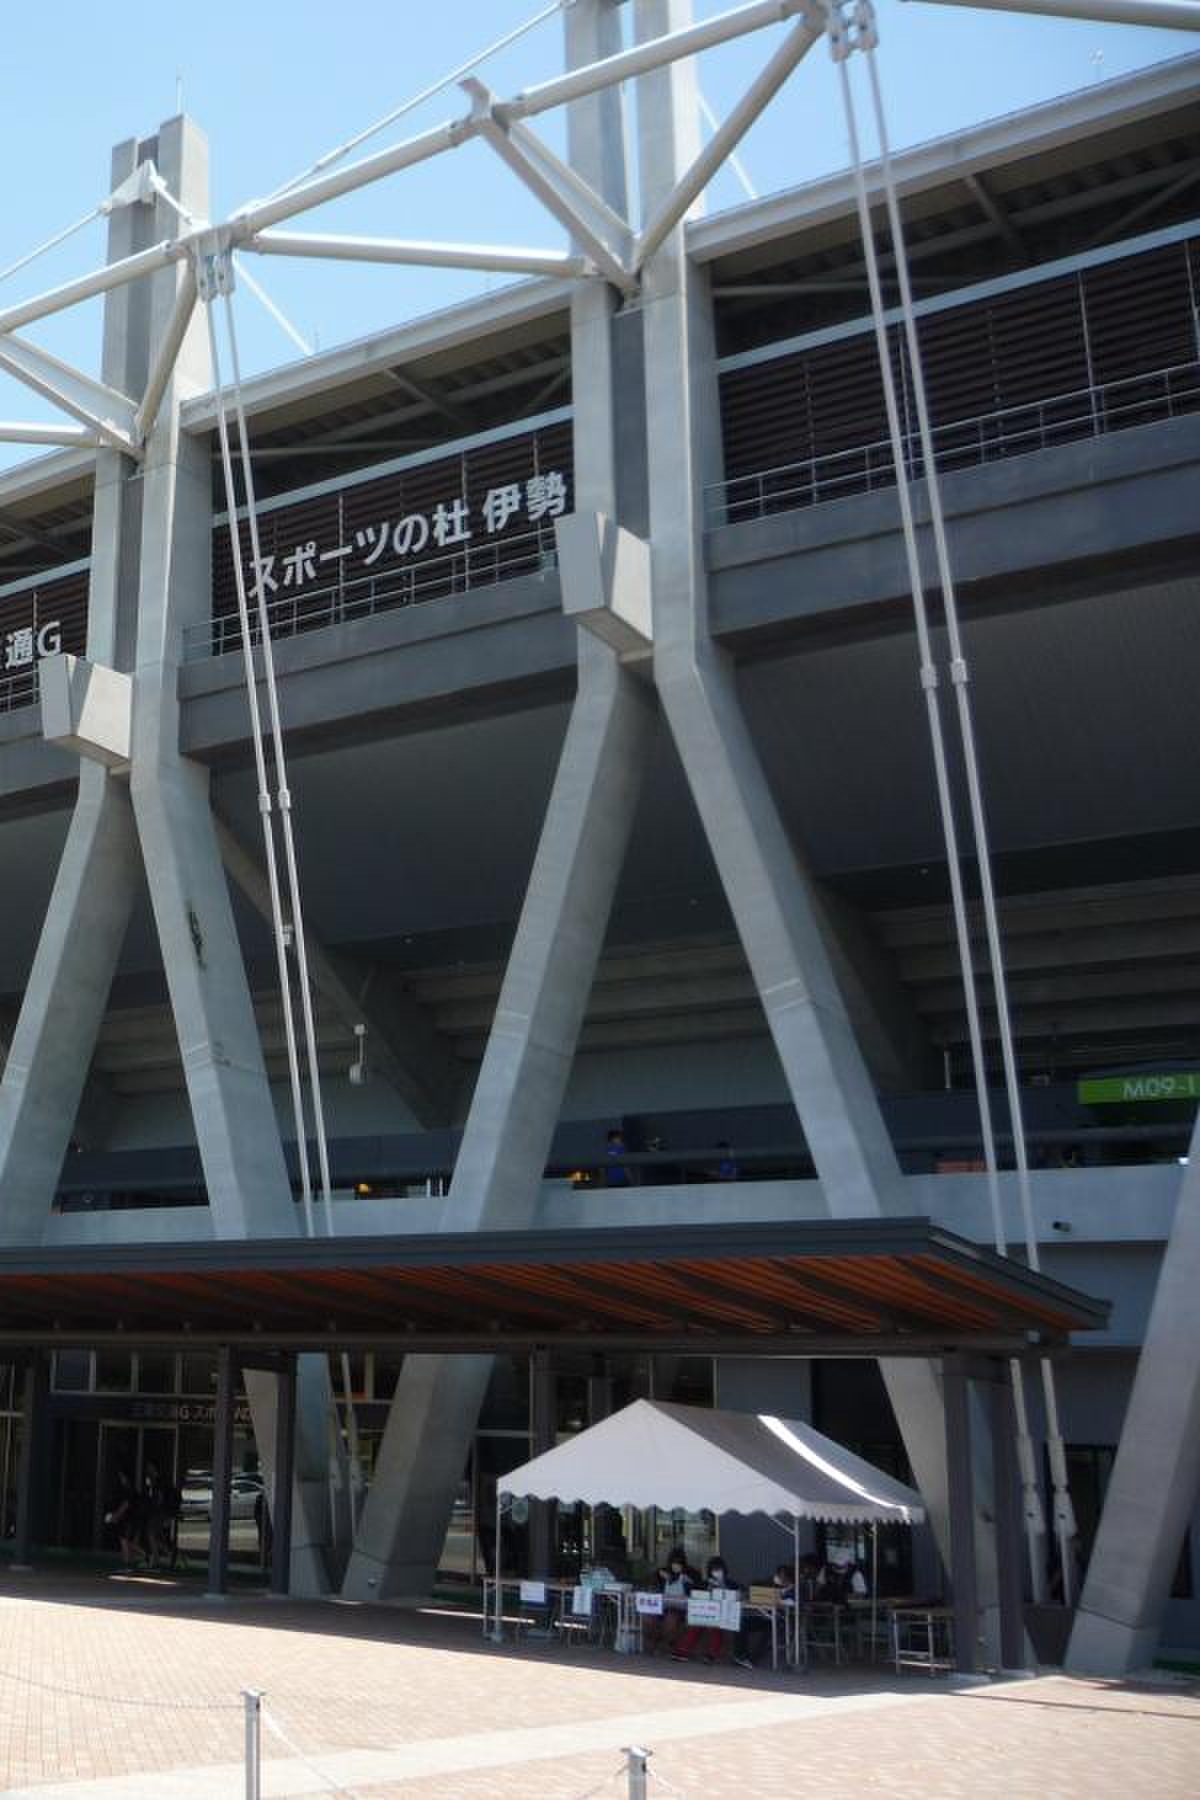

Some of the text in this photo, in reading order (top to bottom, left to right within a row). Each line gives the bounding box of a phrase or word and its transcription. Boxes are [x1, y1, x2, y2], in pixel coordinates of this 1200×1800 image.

[248, 471, 567, 597] スポーツの杜 伊勢
